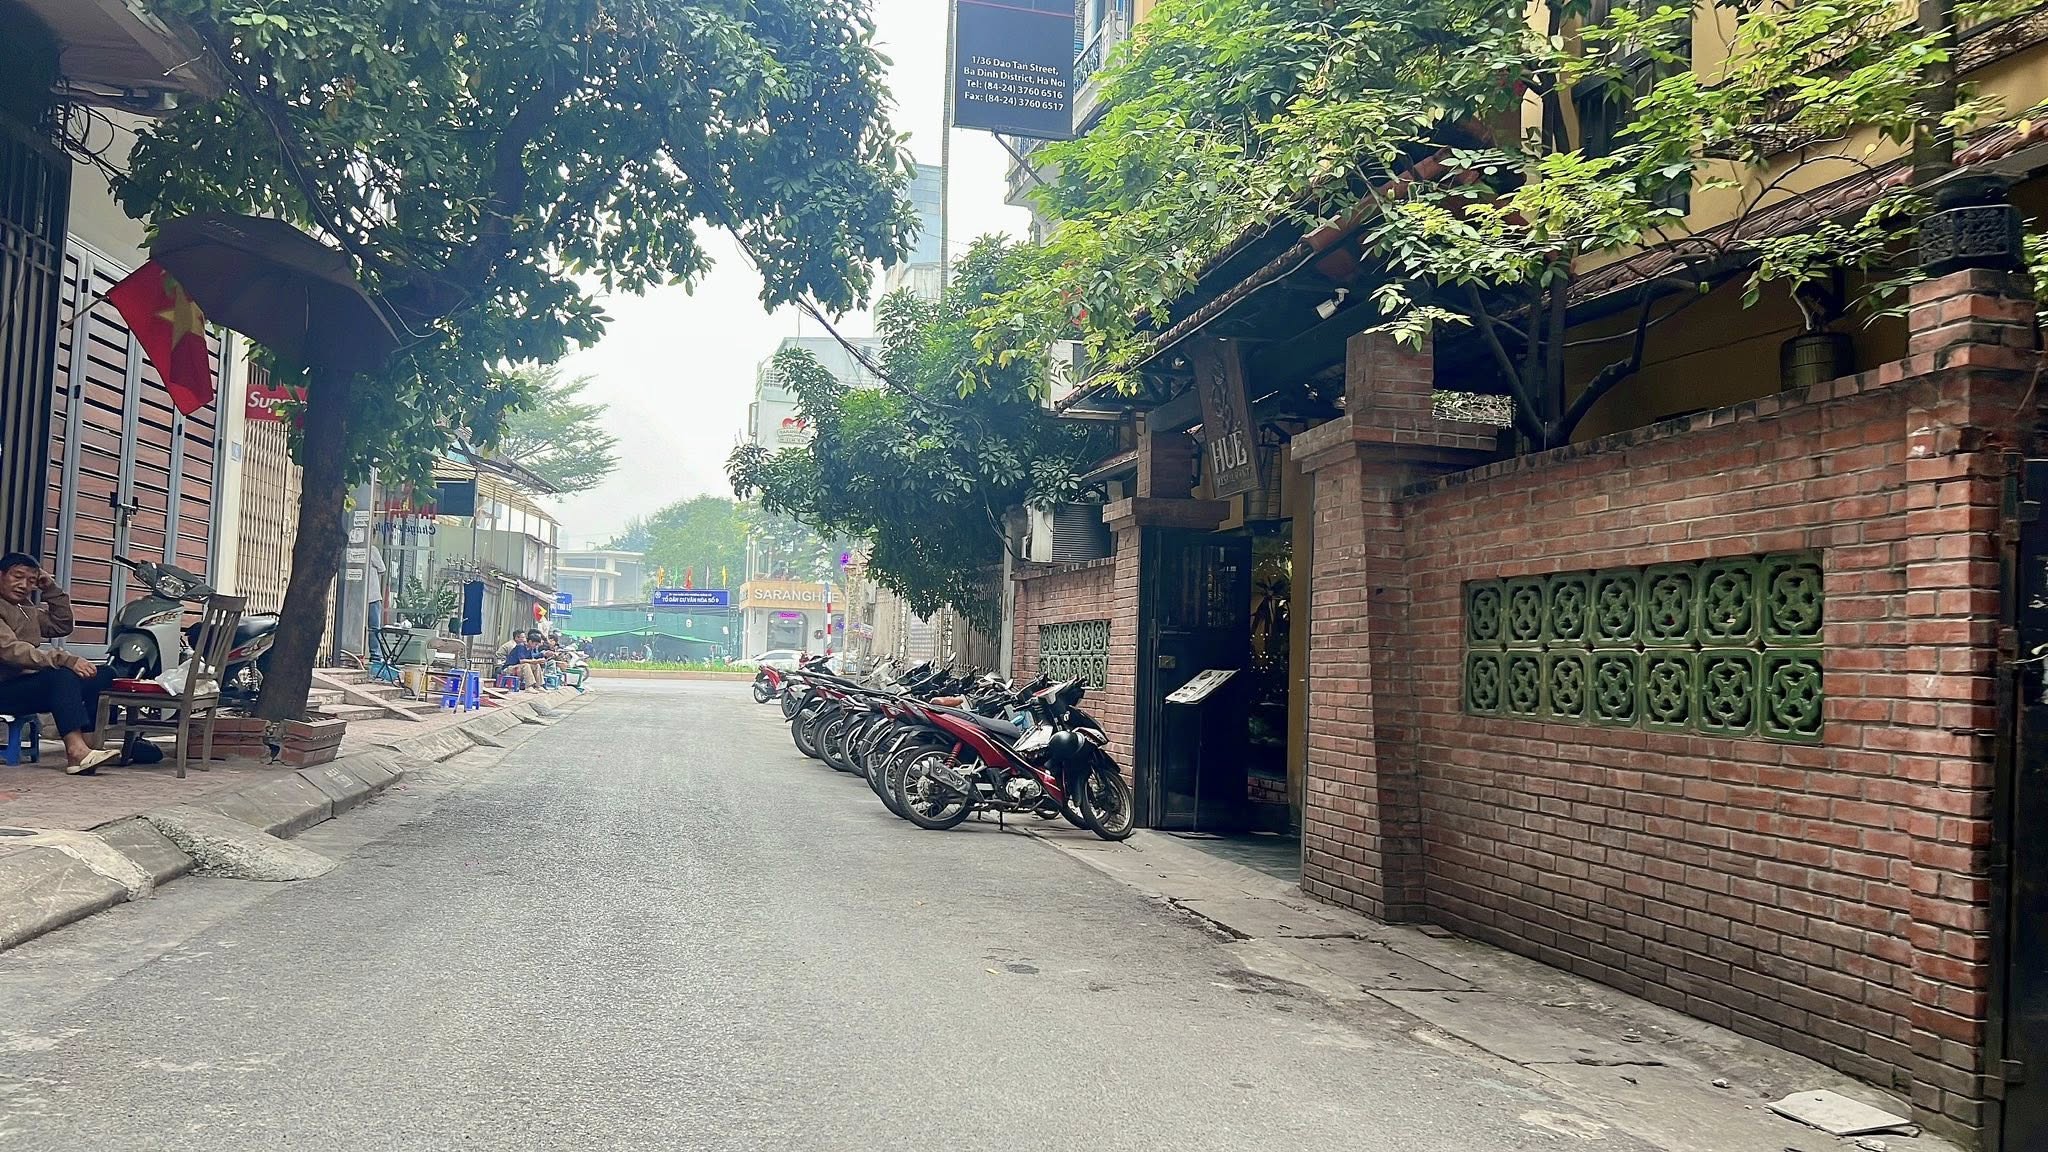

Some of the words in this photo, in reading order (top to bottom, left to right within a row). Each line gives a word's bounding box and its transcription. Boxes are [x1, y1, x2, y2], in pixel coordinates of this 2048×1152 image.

[972, 56, 991, 65] 1/36
[993, 58, 1011, 68] Dao
[1012, 60, 1028, 70] Tan
[1030, 63, 1059, 75] Street,
[963, 66, 975, 75] Ba
[977, 68, 999, 79] Dinh
[1000, 71, 1035, 84] District,
[1037, 76, 1049, 85] Ha
[1050, 77, 1066, 87] Noi
[966, 79, 982, 88] Tel:
[984, 81, 1016, 94] (84-24)
[1017, 86, 1040, 95] 3760
[1041, 89, 1063, 99] 6516
[964, 91, 983, 101] Fax:
[985, 93, 1017, 106] (84-24)
[1018, 98, 1040, 108] 3760
[1042, 101, 1064, 111] 6517
[248, 391, 308, 413] Supr
[754, 588, 841, 603] SARANGHE
